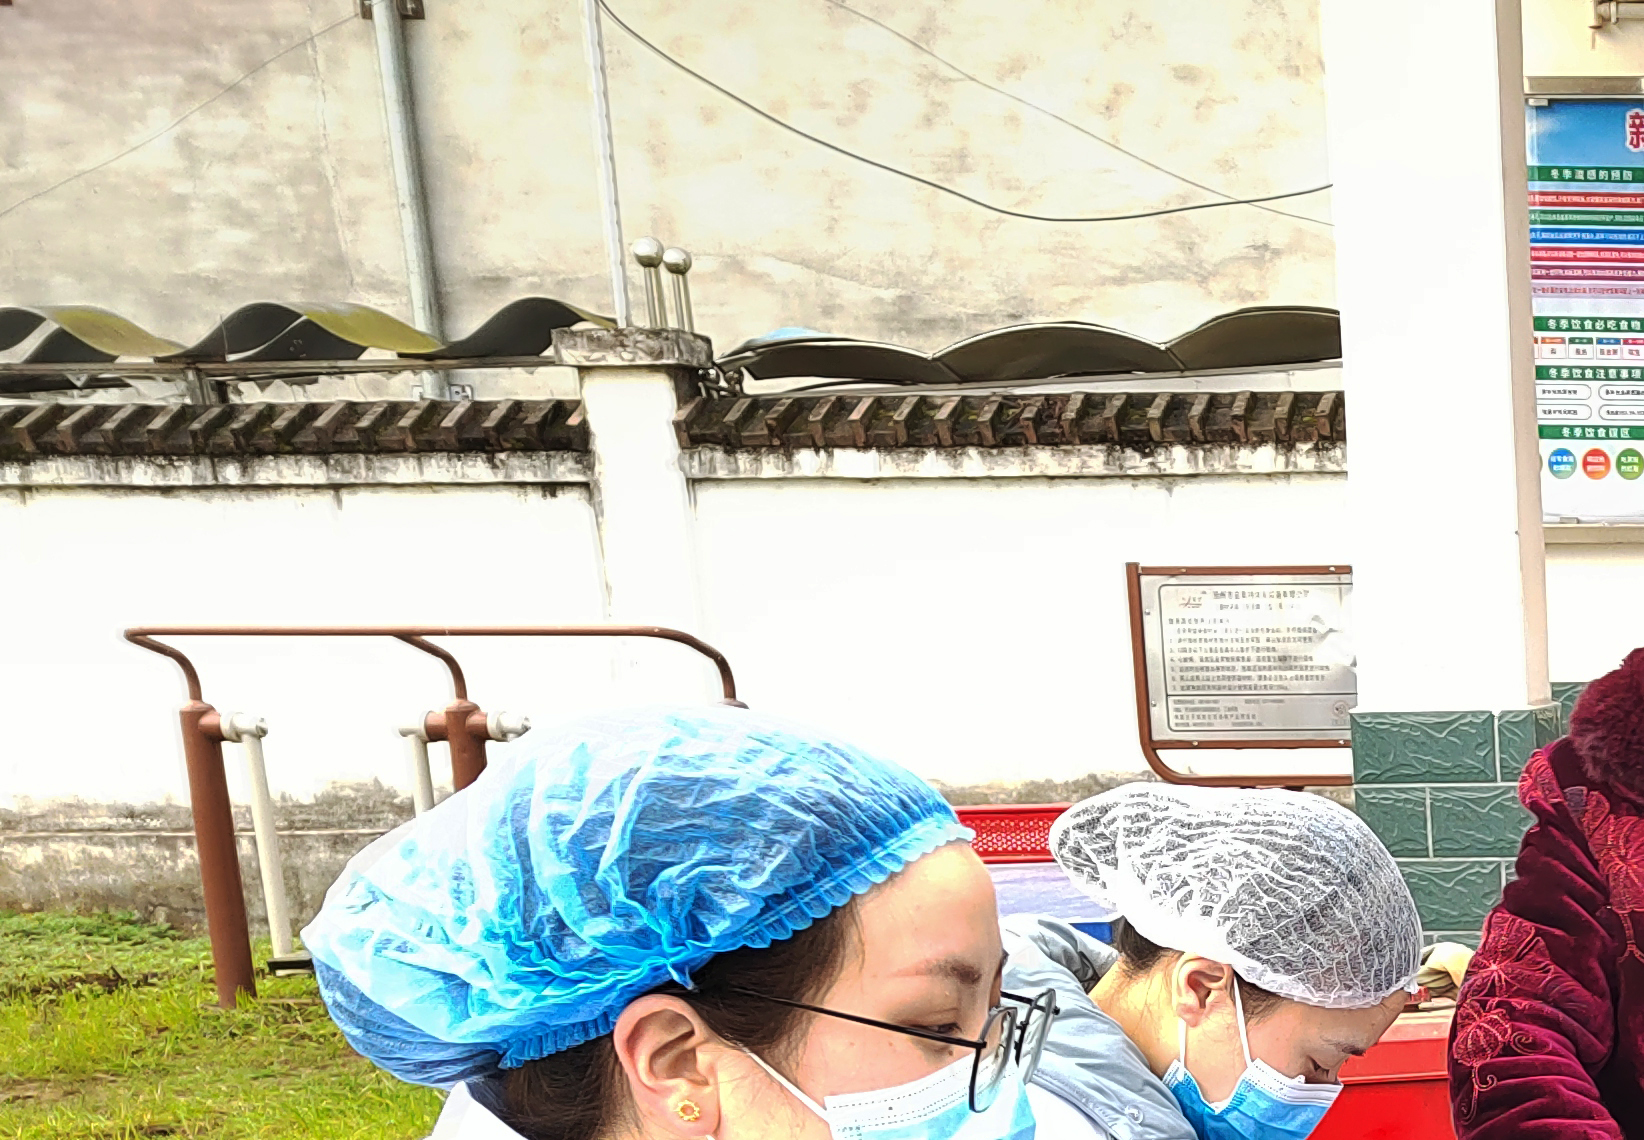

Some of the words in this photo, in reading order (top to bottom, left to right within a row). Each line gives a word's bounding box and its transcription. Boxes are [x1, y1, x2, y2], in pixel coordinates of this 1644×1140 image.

[1549, 168, 1633, 181] 冬季流感的预防
[1547, 319, 1642, 331] 冬季饮食必吃食物
[1548, 368, 1642, 380] 冬季饮食注意事项
